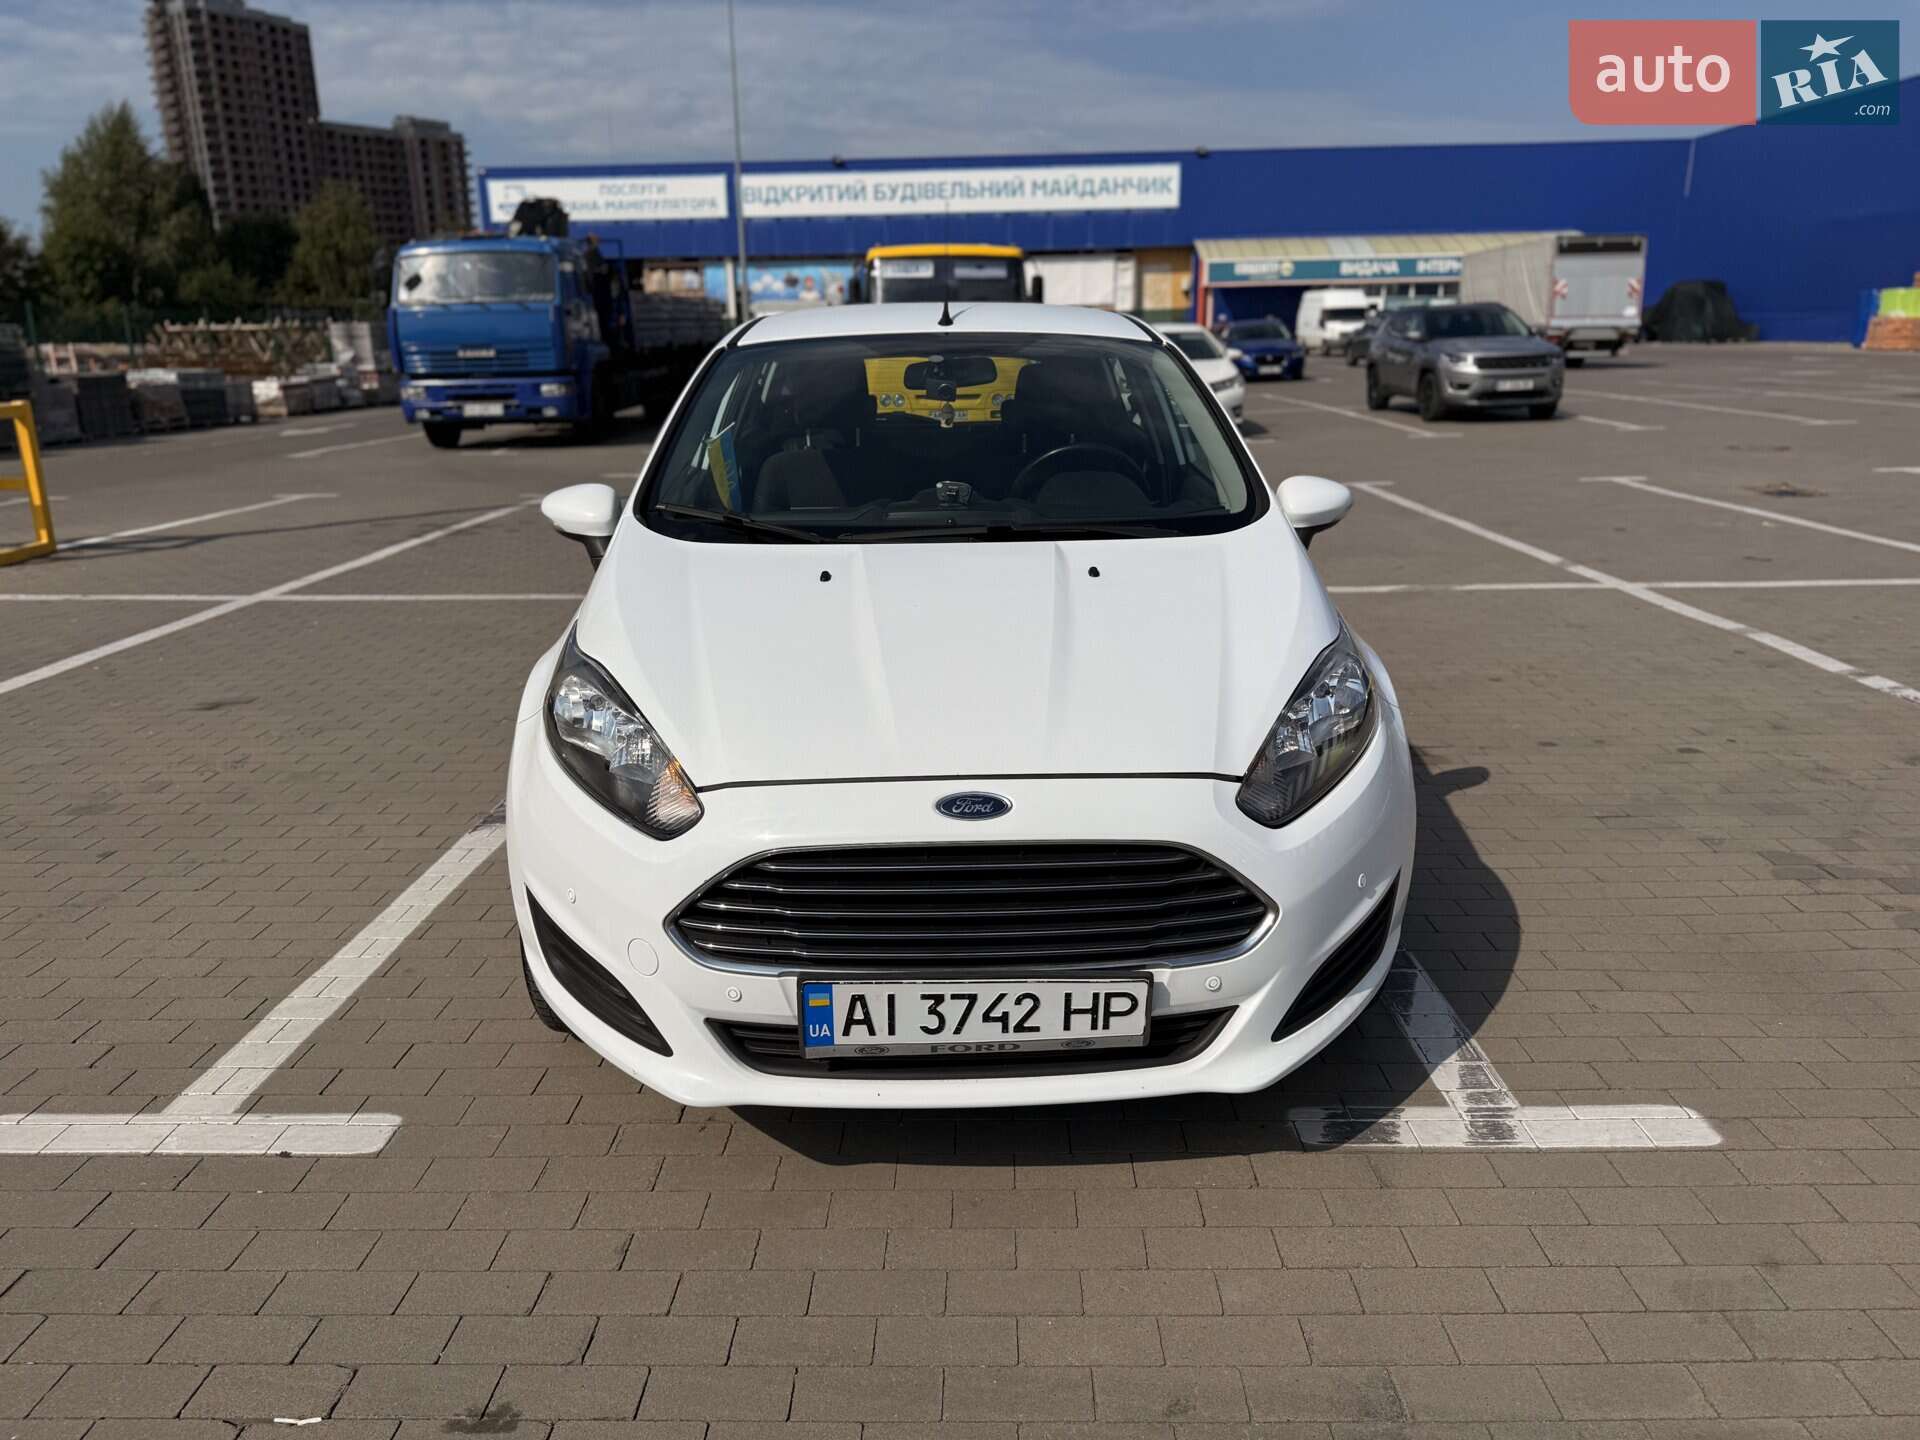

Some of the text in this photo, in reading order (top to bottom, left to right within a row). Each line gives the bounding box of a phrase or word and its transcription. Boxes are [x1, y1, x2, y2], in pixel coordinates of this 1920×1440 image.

[599, 183, 667, 195] ПОСЛУГИ
[743, 173, 1173, 206] ВІДКРИТИЙ БУДІВЕЛЬНИЙ МАЙДАНЧИК
[952, 797, 994, 813] Ford
[841, 991, 1139, 1037] AI 3742 HP
[808, 1023, 831, 1038] UA
[930, 1042, 1021, 1053] FORD
